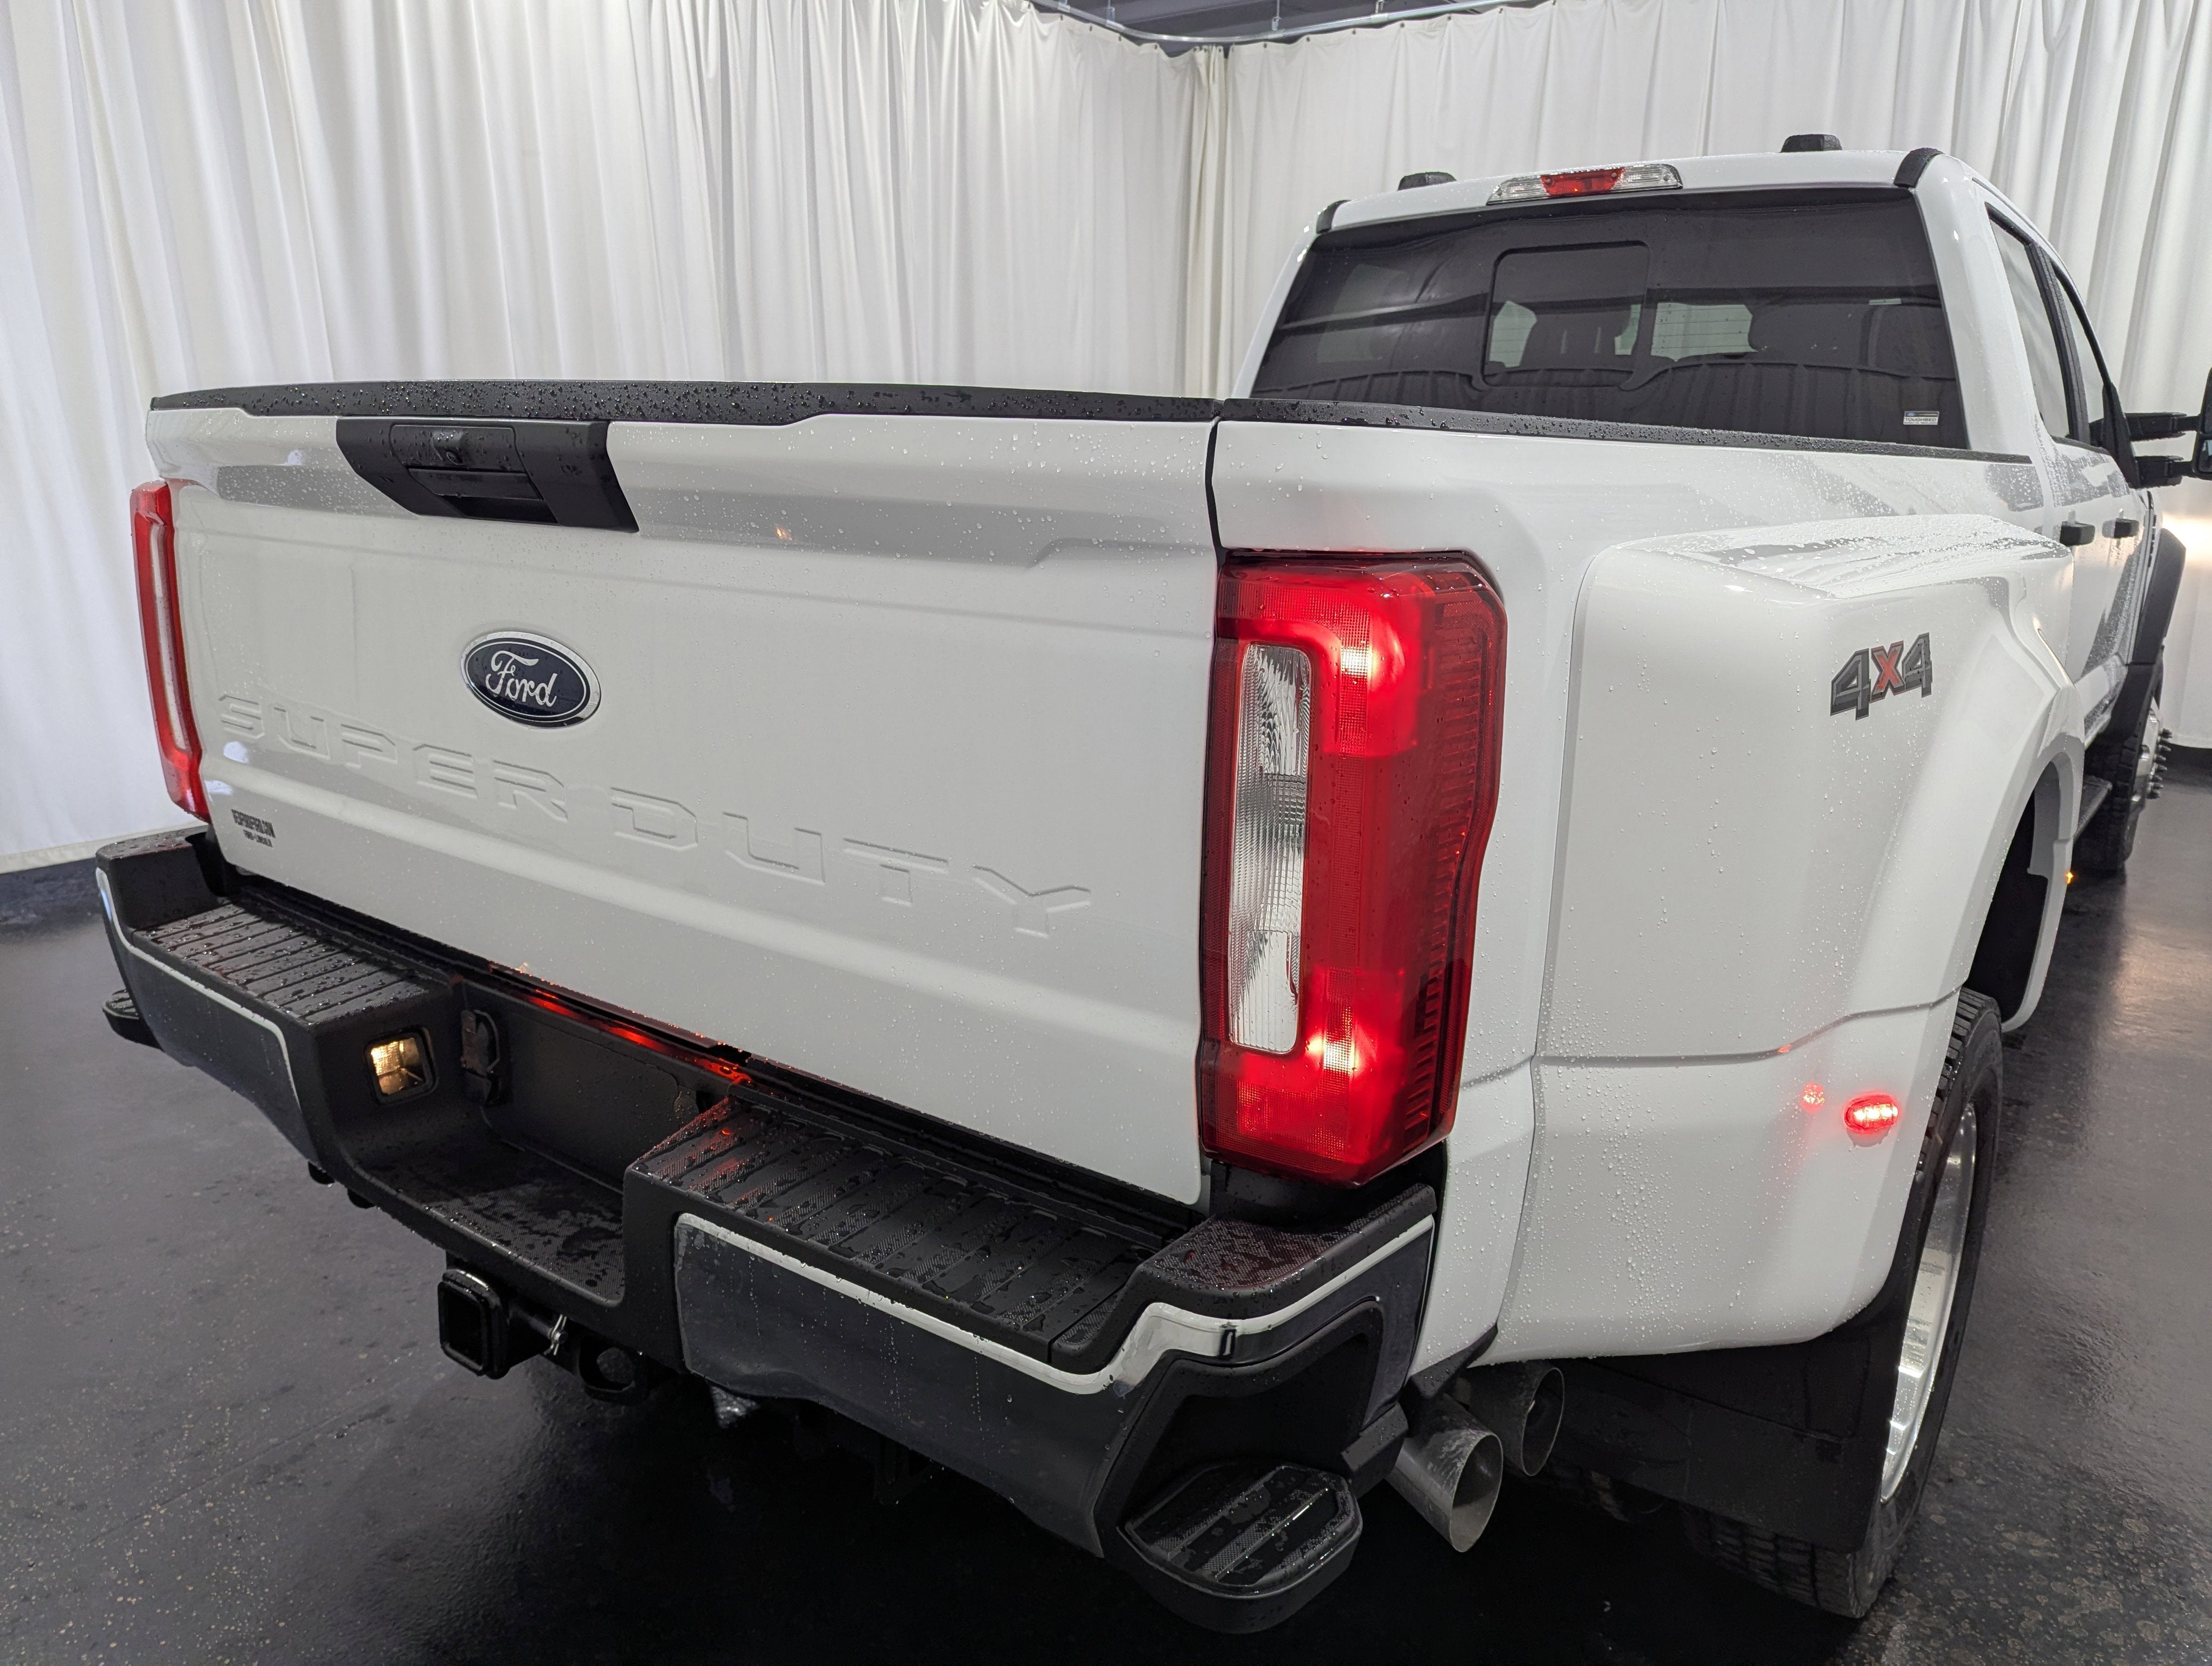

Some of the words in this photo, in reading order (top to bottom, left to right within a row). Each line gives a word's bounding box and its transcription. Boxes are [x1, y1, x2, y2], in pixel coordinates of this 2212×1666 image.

[486, 650, 558, 707] Ford
[218, 695, 568, 822] SUPER
[610, 786, 1091, 938] DUTY
